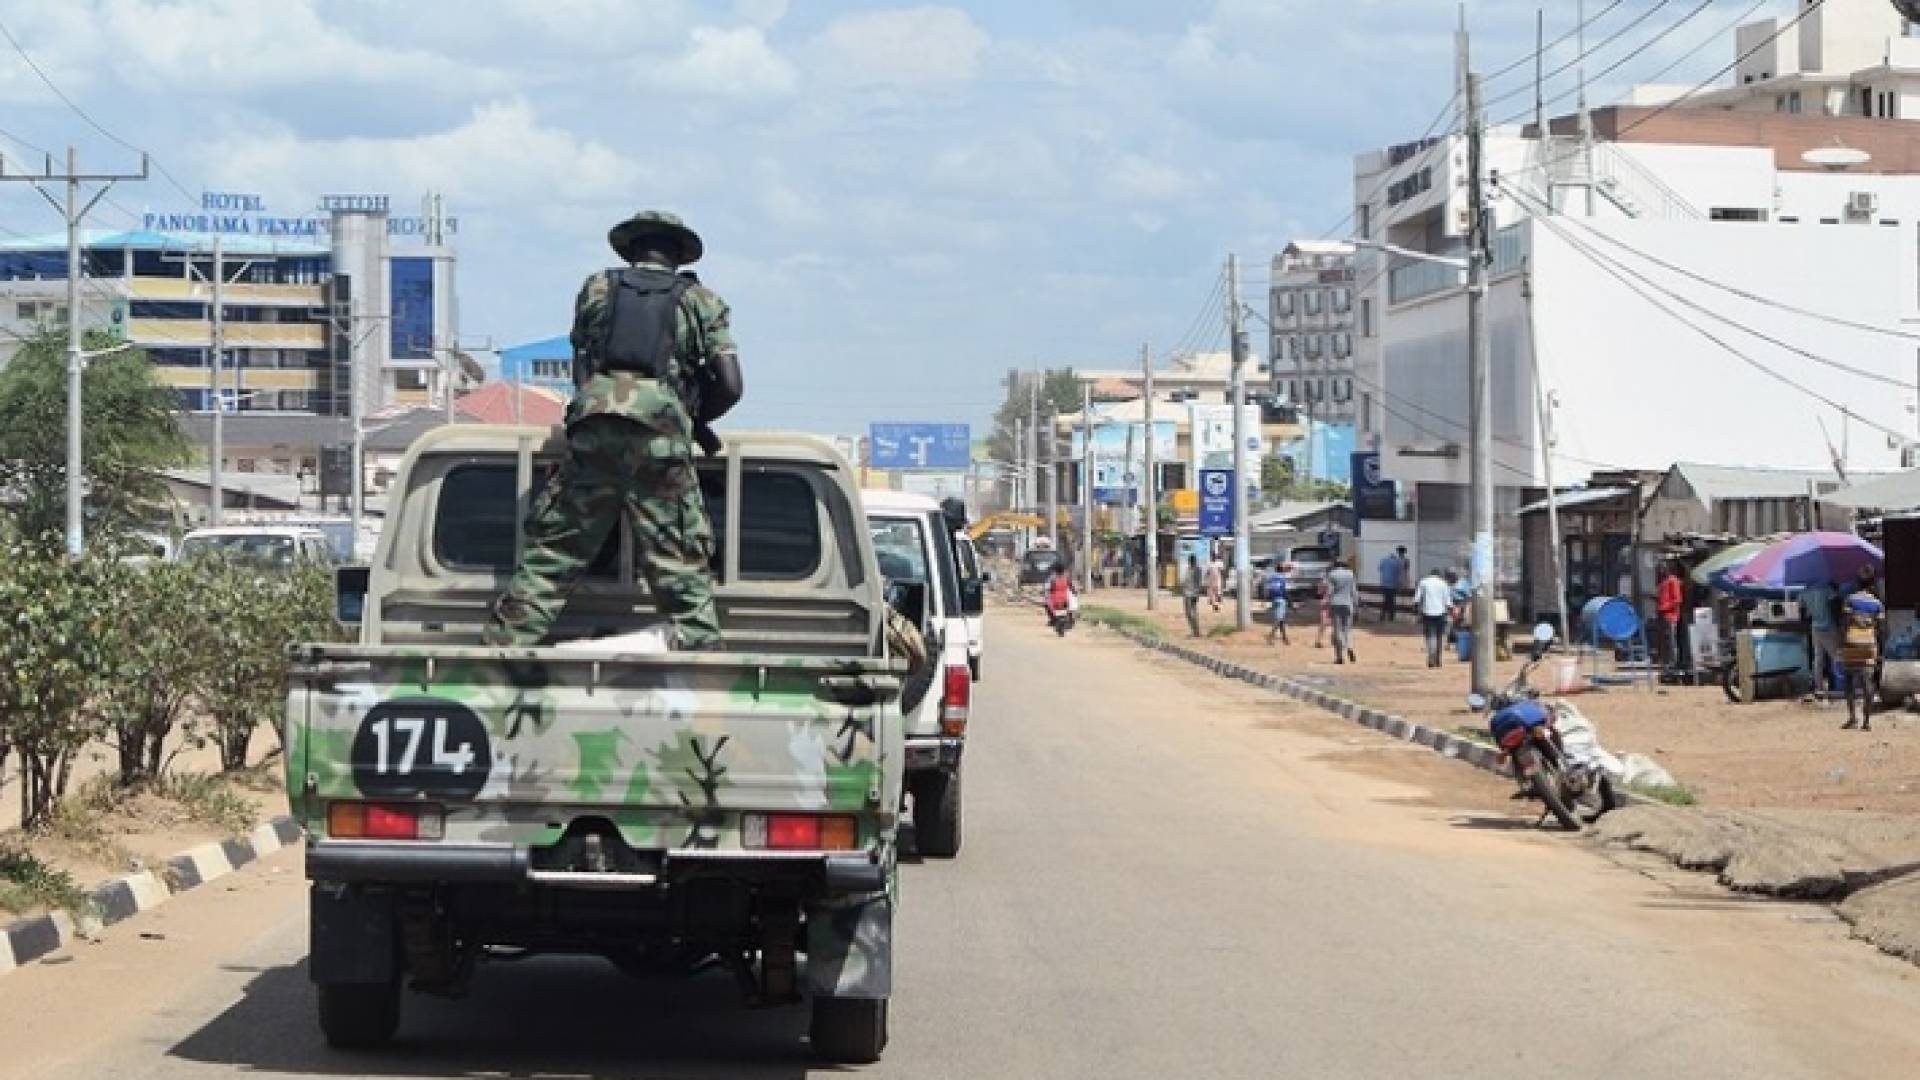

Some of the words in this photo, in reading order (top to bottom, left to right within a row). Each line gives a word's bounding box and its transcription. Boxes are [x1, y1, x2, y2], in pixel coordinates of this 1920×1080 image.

[202, 192, 264, 210] HOTEL
[144, 213, 249, 232] PANORAMA
[371, 717, 475, 774] 174
